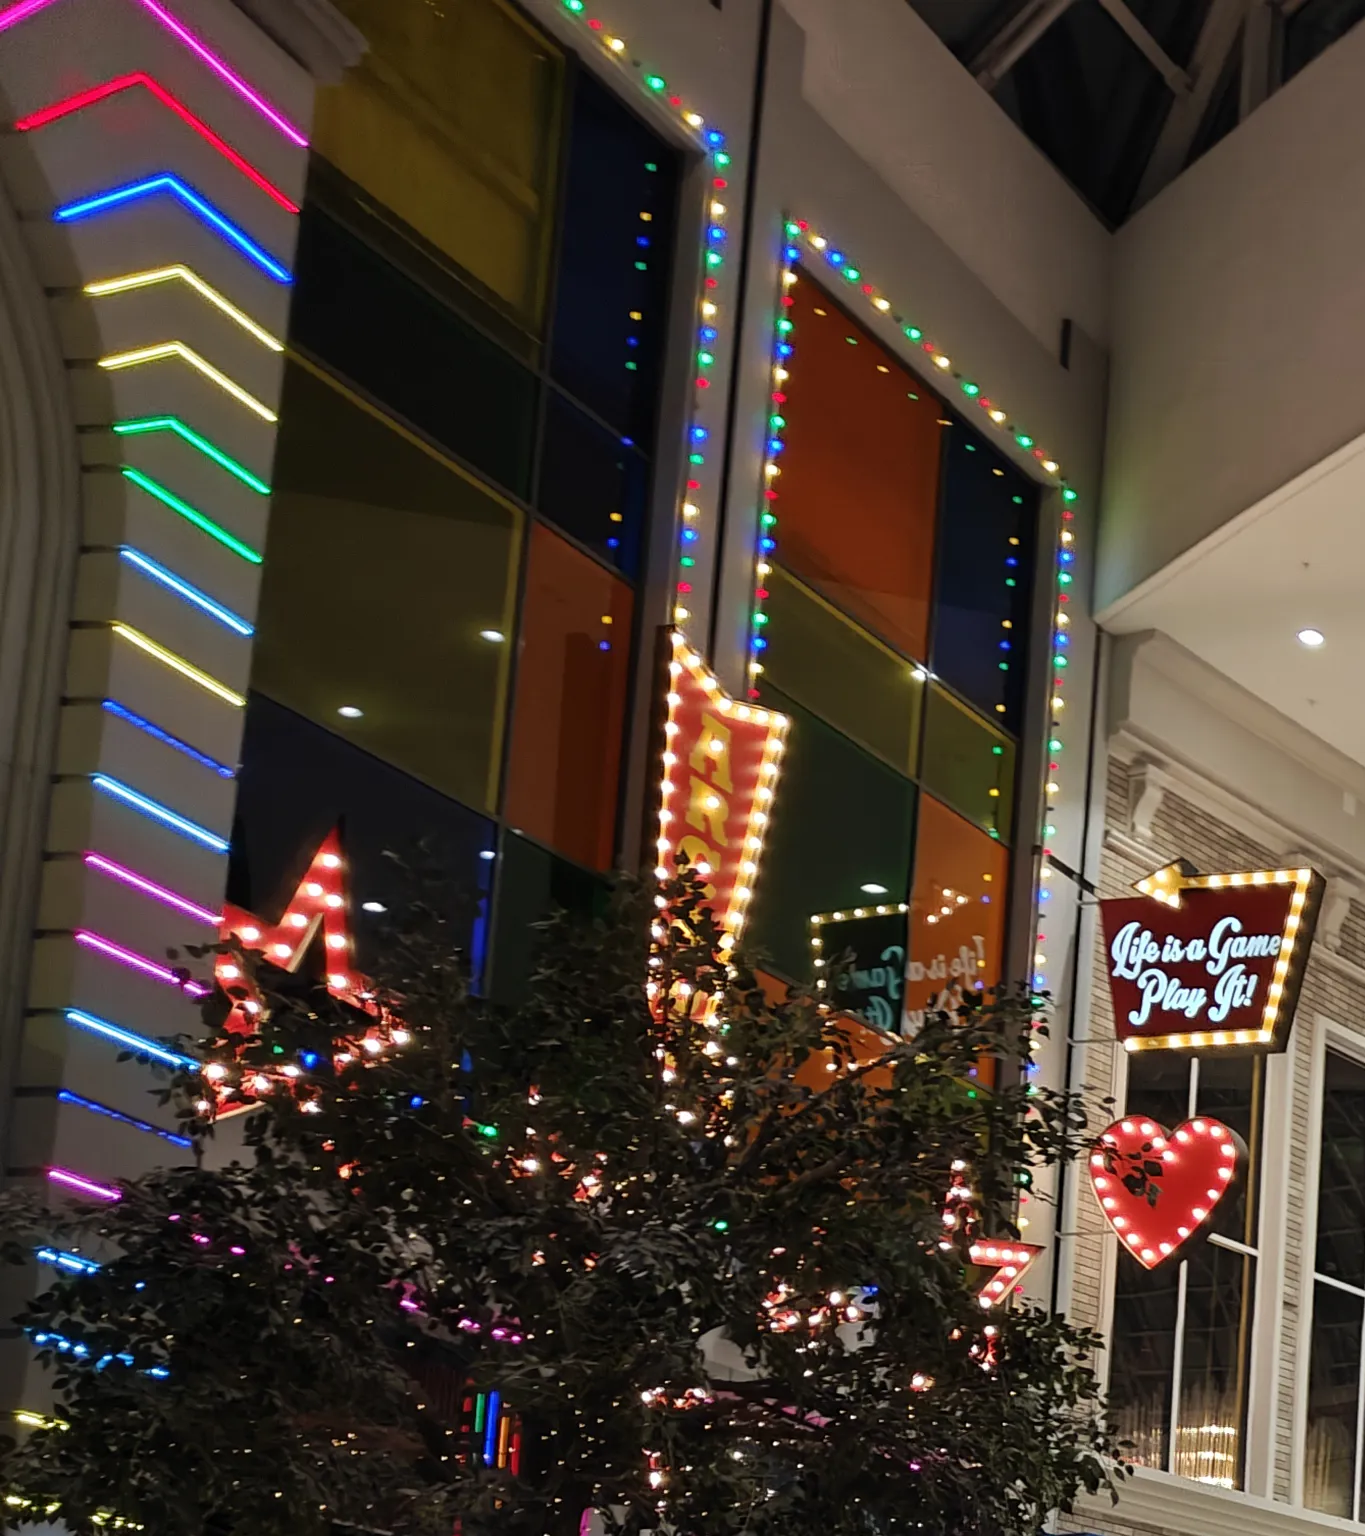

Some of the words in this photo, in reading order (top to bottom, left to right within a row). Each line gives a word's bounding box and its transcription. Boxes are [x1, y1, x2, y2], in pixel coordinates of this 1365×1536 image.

[1111, 921, 1160, 980] Life
[1161, 935, 1187, 964] is
[1187, 937, 1207, 963] a
[1206, 916, 1282, 975] Game
[1128, 968, 1207, 1025] Play
[1208, 964, 1258, 1023] It!
